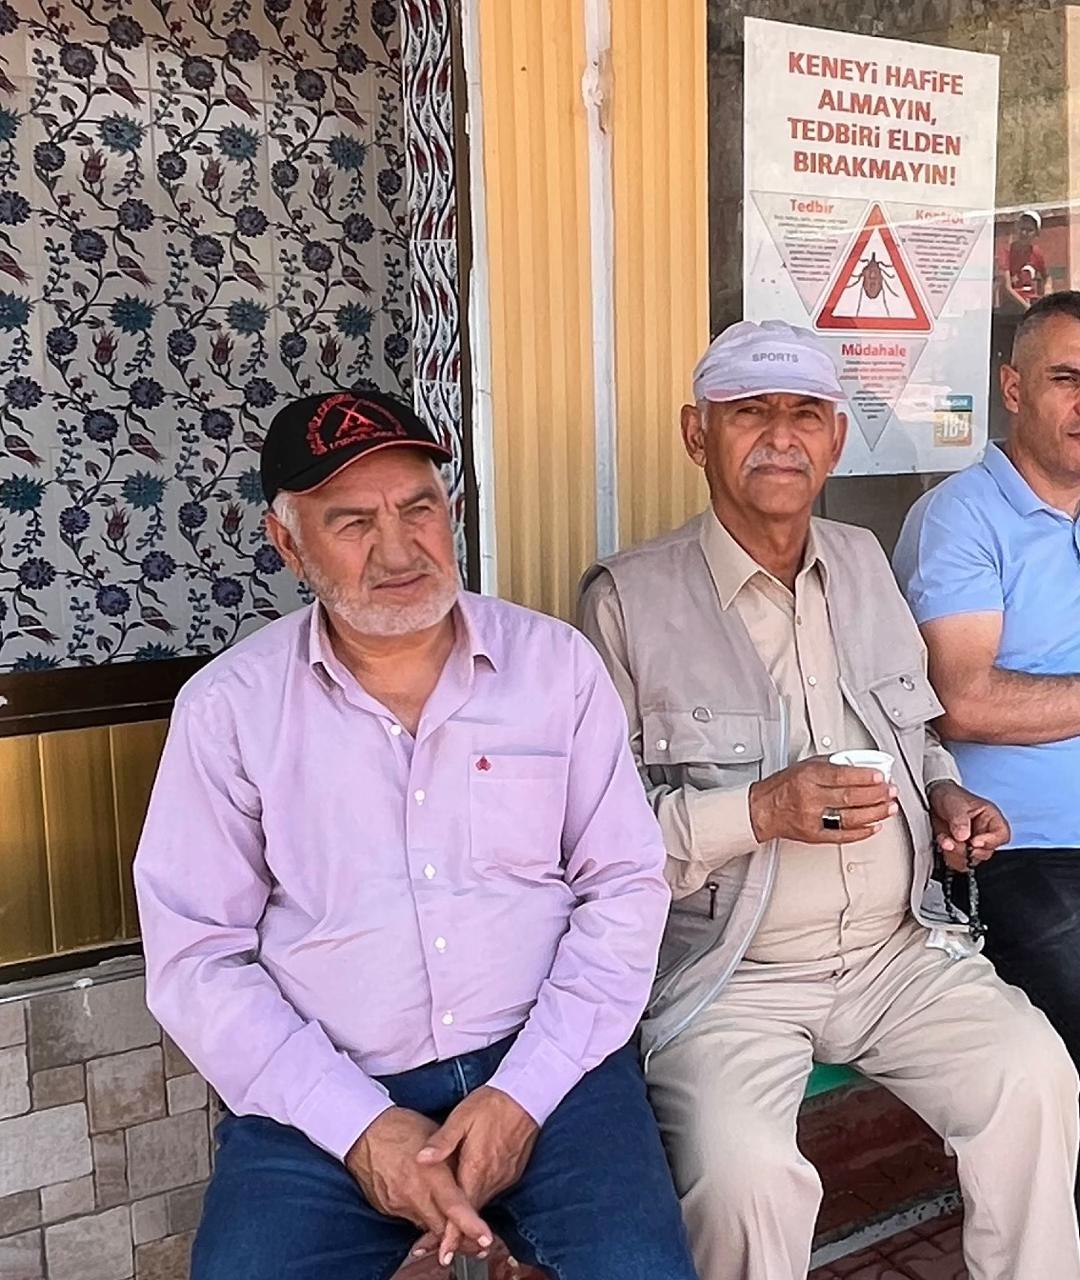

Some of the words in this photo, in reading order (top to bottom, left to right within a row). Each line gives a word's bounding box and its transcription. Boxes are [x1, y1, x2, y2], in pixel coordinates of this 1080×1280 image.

[817, 89, 937, 125] ALMAYIN,
[888, 128, 961, 156] ELDEN
[793, 151, 956, 186] BIRAKMAYIN!
[790, 199, 834, 214] Tedbir
[752, 352, 799, 363] SPORTS
[841, 343, 906, 357] Müdahale
